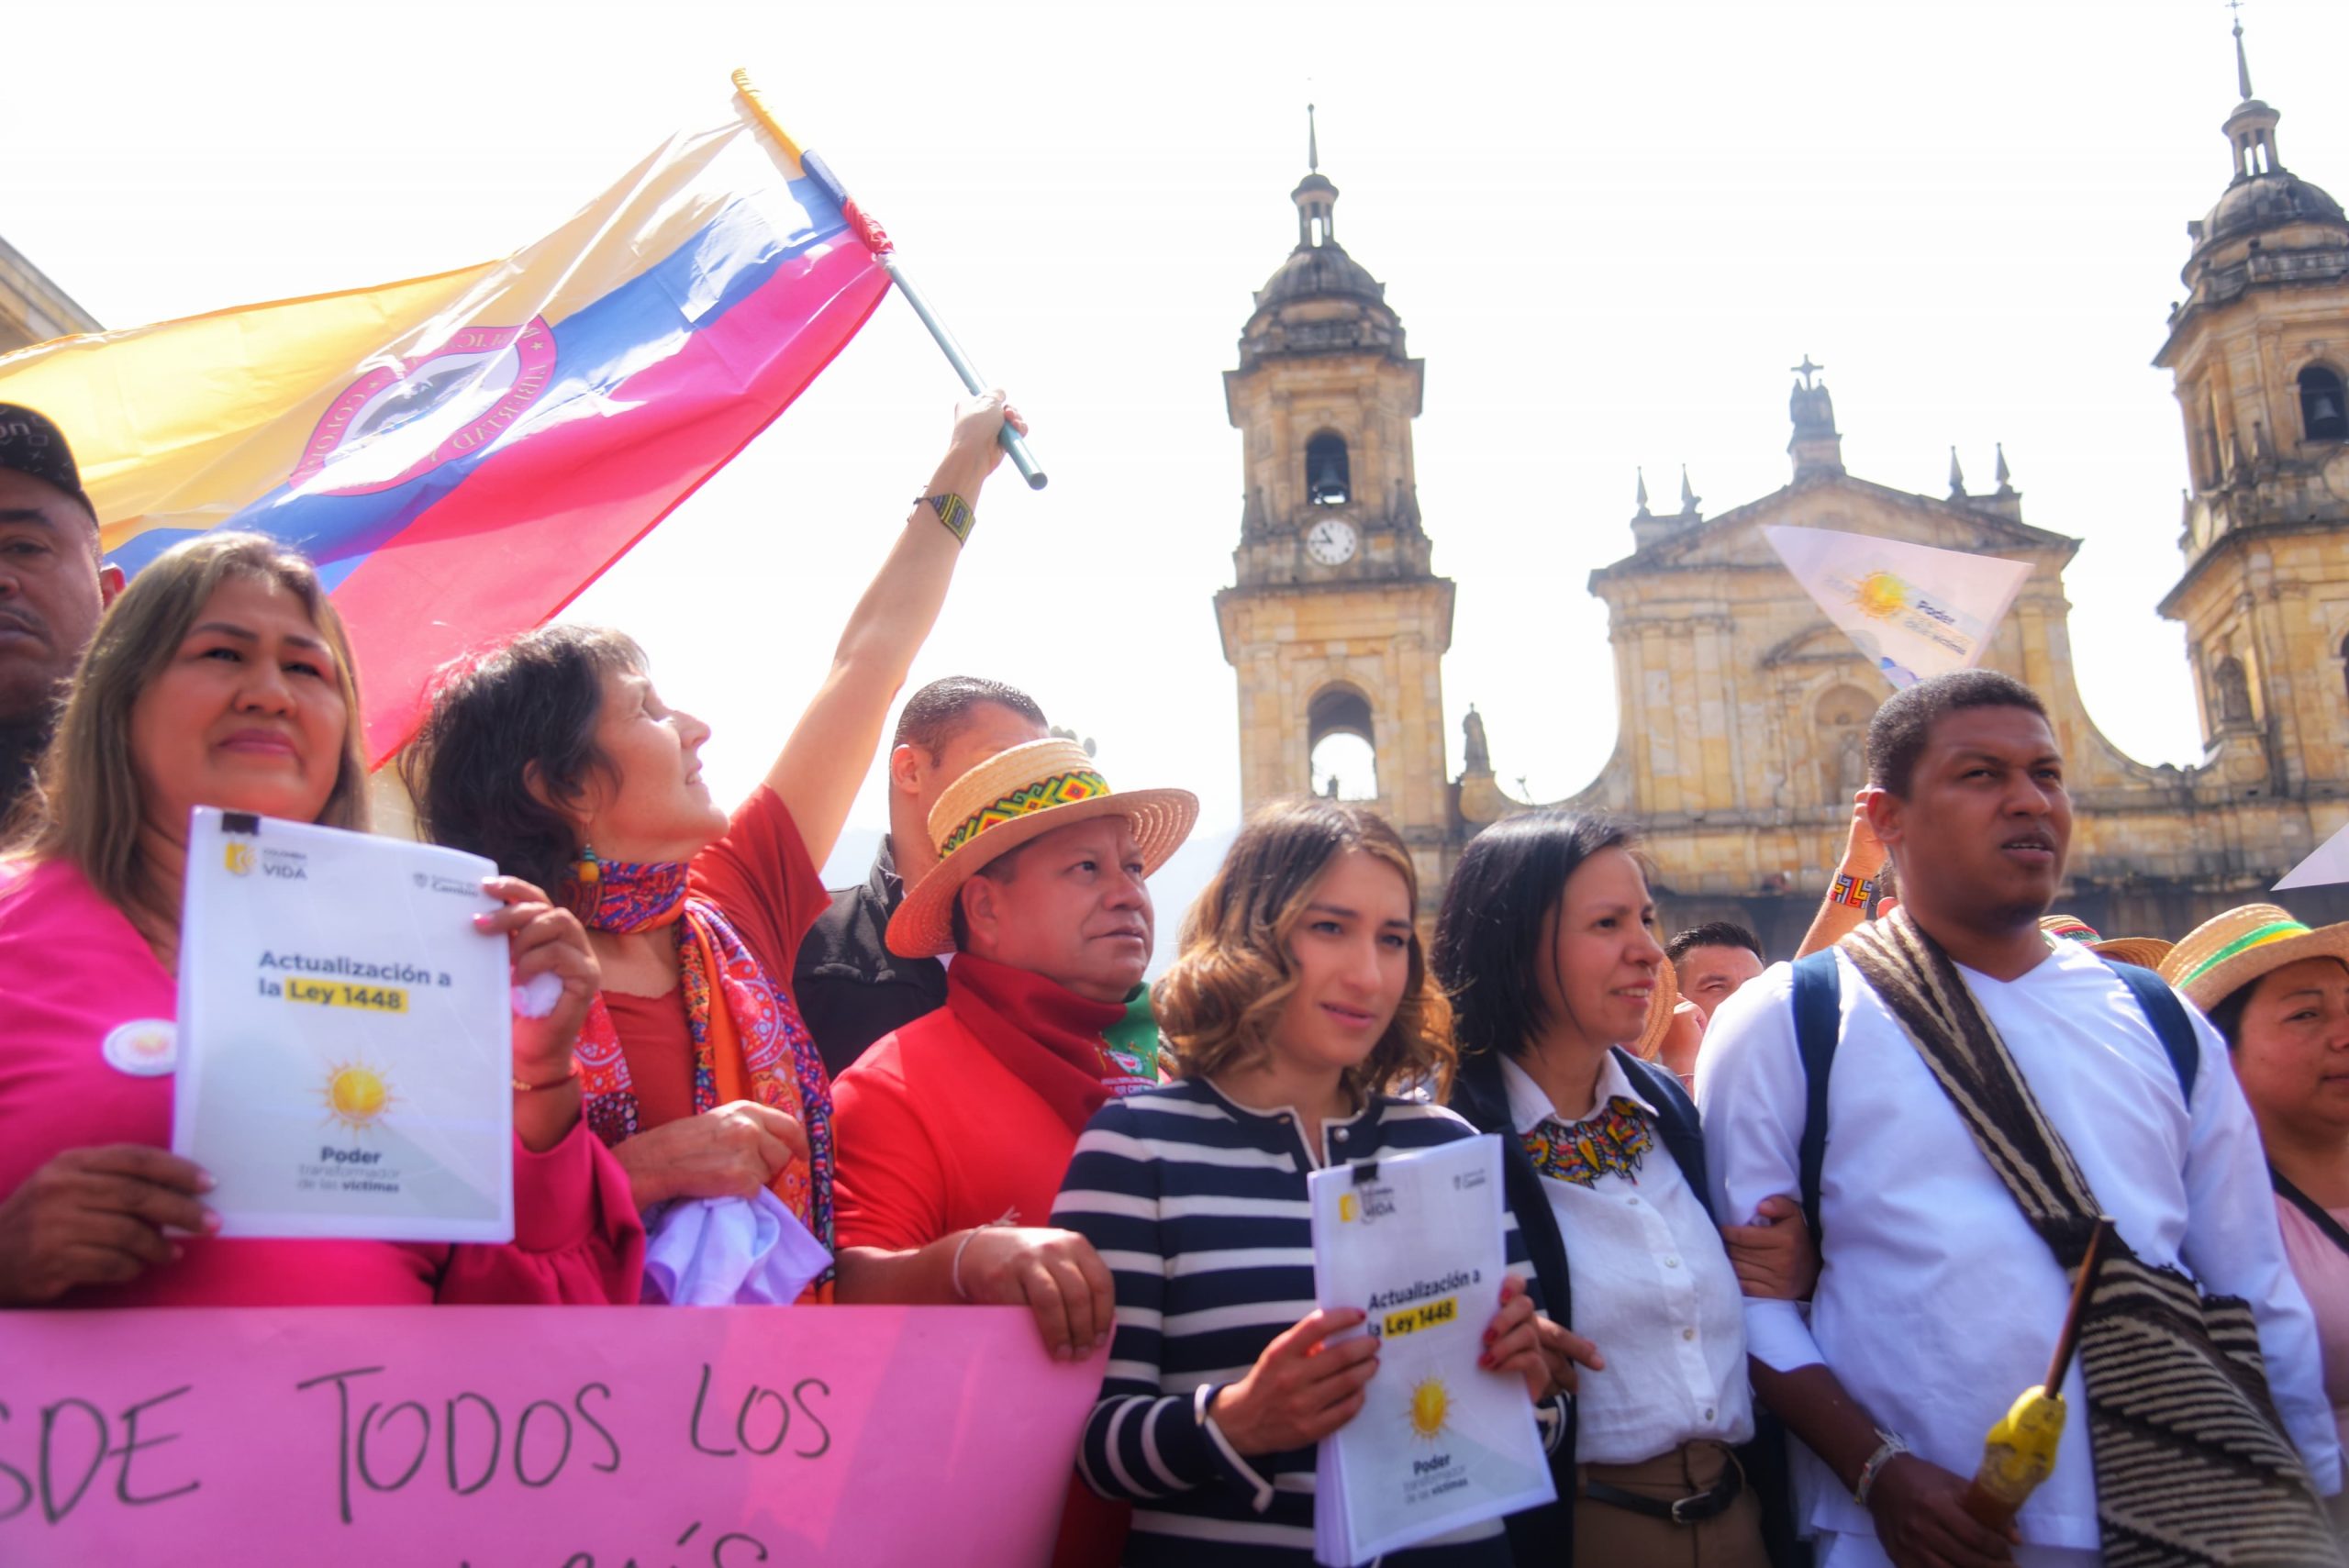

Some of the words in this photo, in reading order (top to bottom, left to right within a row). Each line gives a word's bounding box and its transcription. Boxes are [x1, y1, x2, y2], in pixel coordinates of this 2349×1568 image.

[262, 864, 308, 880] VIDA
[258, 951, 431, 984] Actualización
[438, 972, 452, 987] a
[258, 978, 281, 996] la
[290, 981, 334, 1004] Ley
[343, 986, 402, 1009] 1448
[320, 1145, 382, 1164] Poder
[1367, 1271, 1470, 1311] Actualización
[1472, 1269, 1481, 1284] a
[1386, 1314, 1414, 1334] Ley
[1418, 1300, 1453, 1325] 1448
[295, 1365, 621, 1526] TODOS
[690, 1362, 832, 1459] LOS
[1413, 1453, 1451, 1475] Poder
